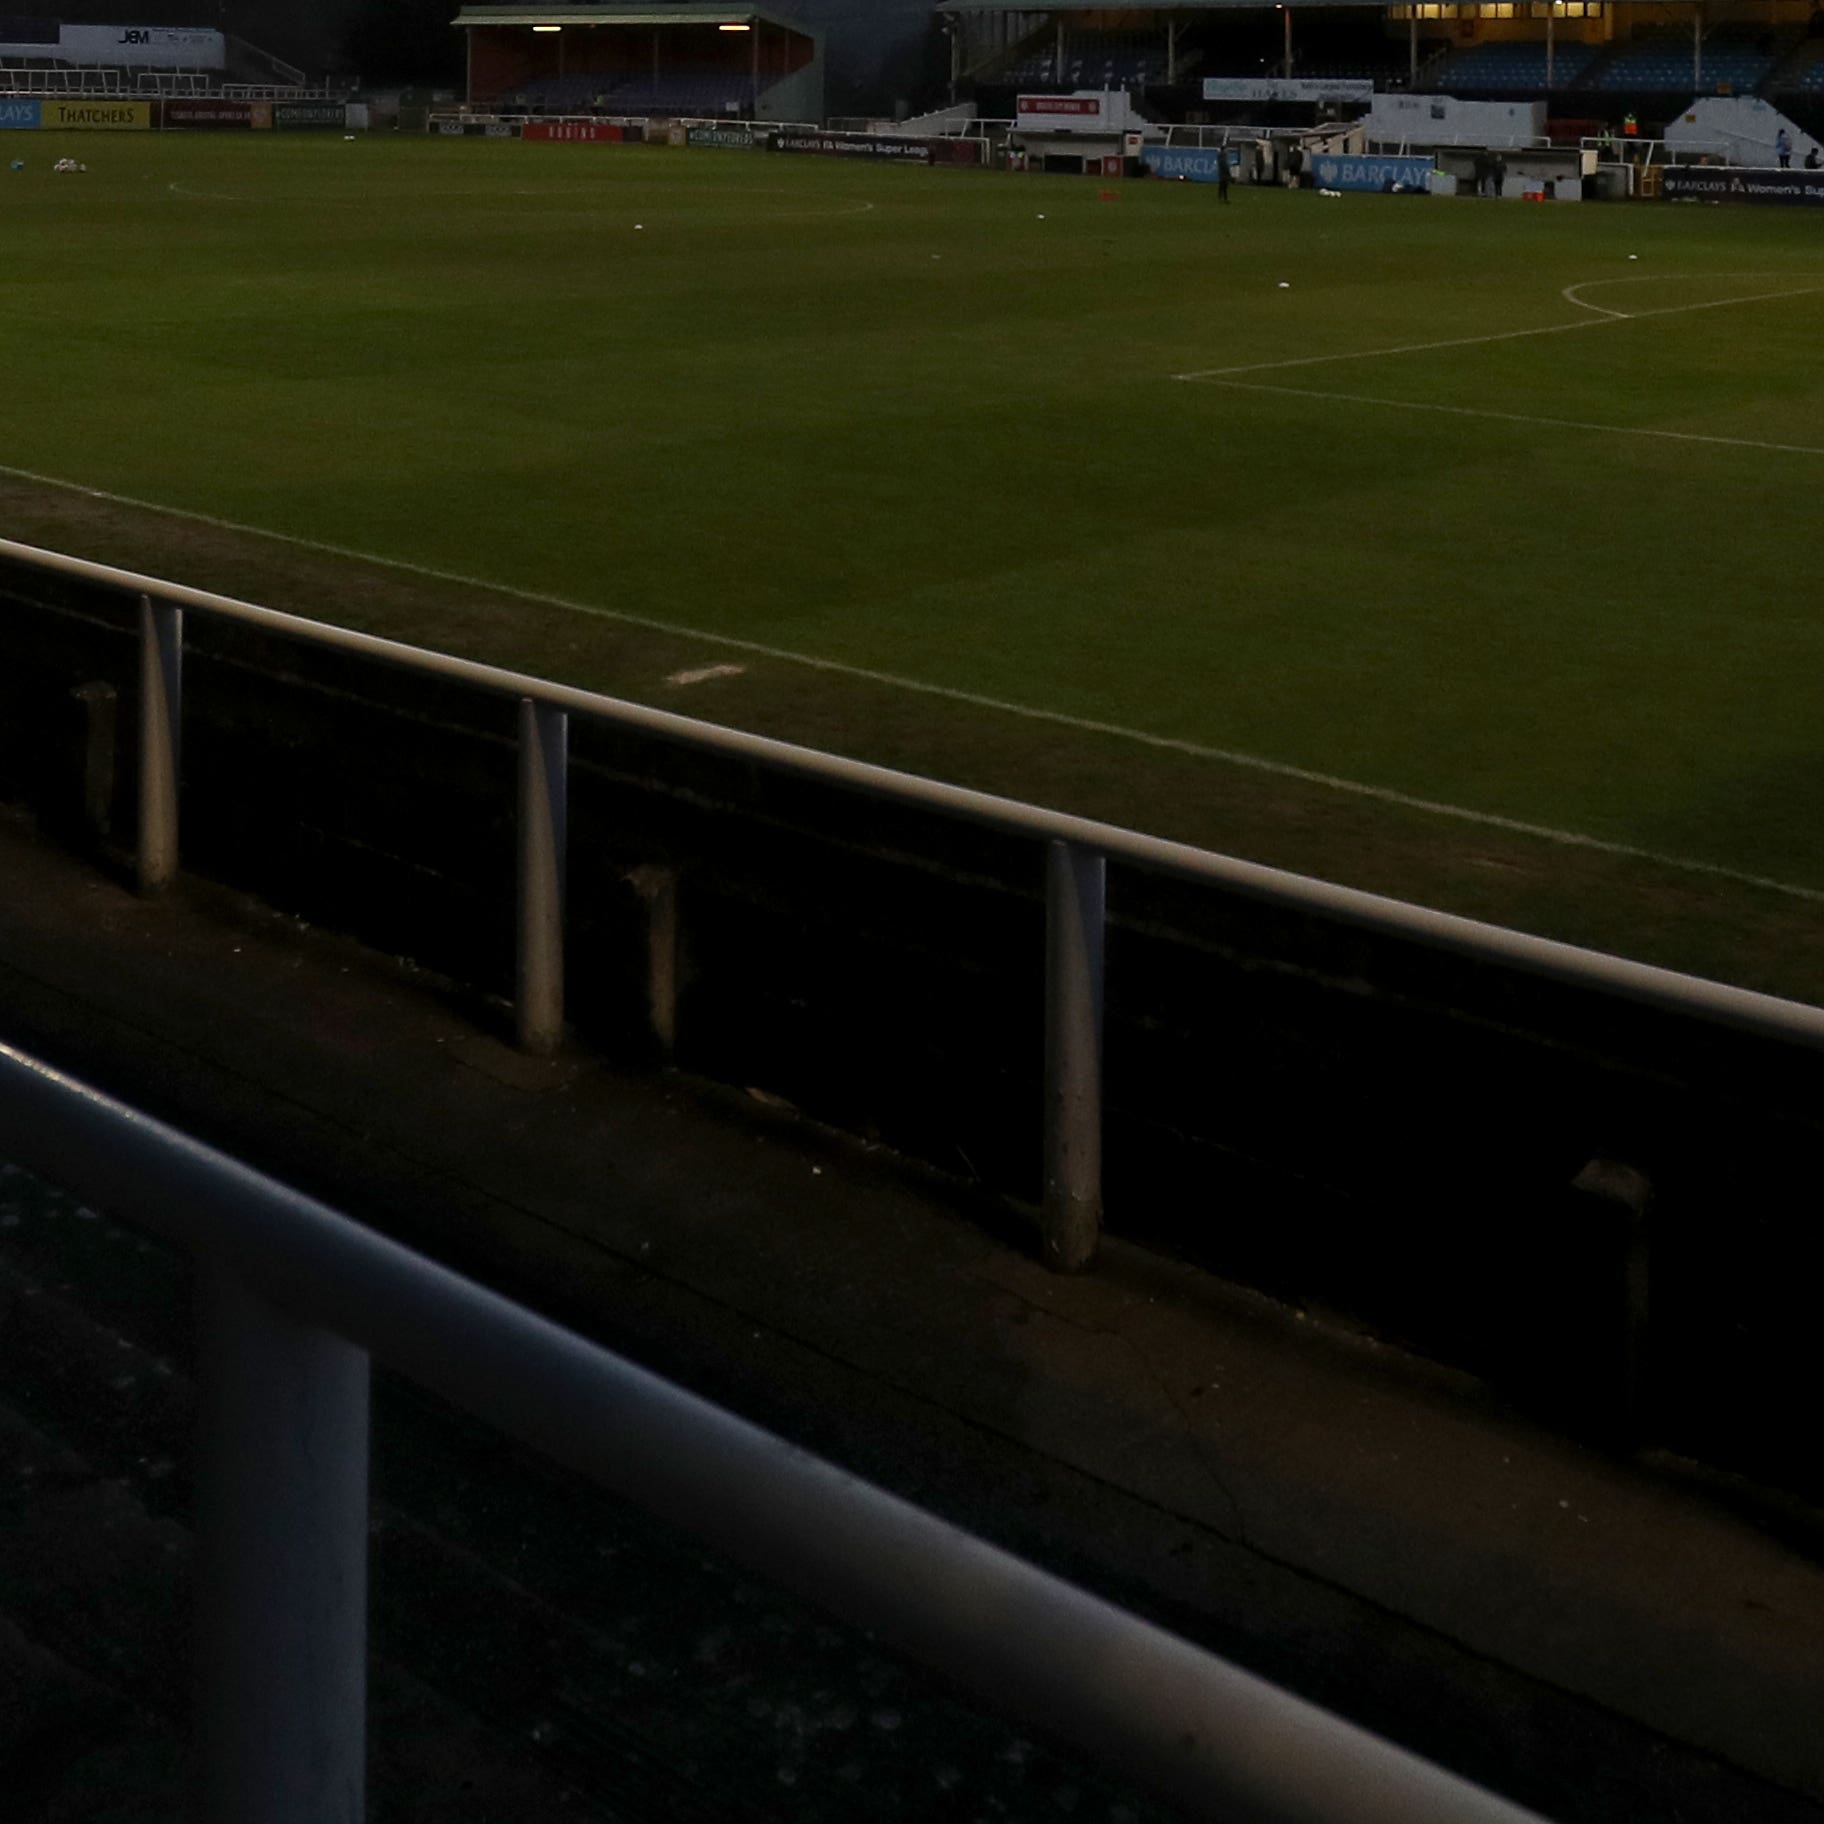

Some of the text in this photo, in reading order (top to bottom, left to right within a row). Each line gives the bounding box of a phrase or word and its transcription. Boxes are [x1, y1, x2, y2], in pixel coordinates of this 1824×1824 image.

[58, 106, 135, 124] THATCHERS
[1677, 180, 1727, 193] BARCLAYS
[1747, 182, 1802, 195] Women's
